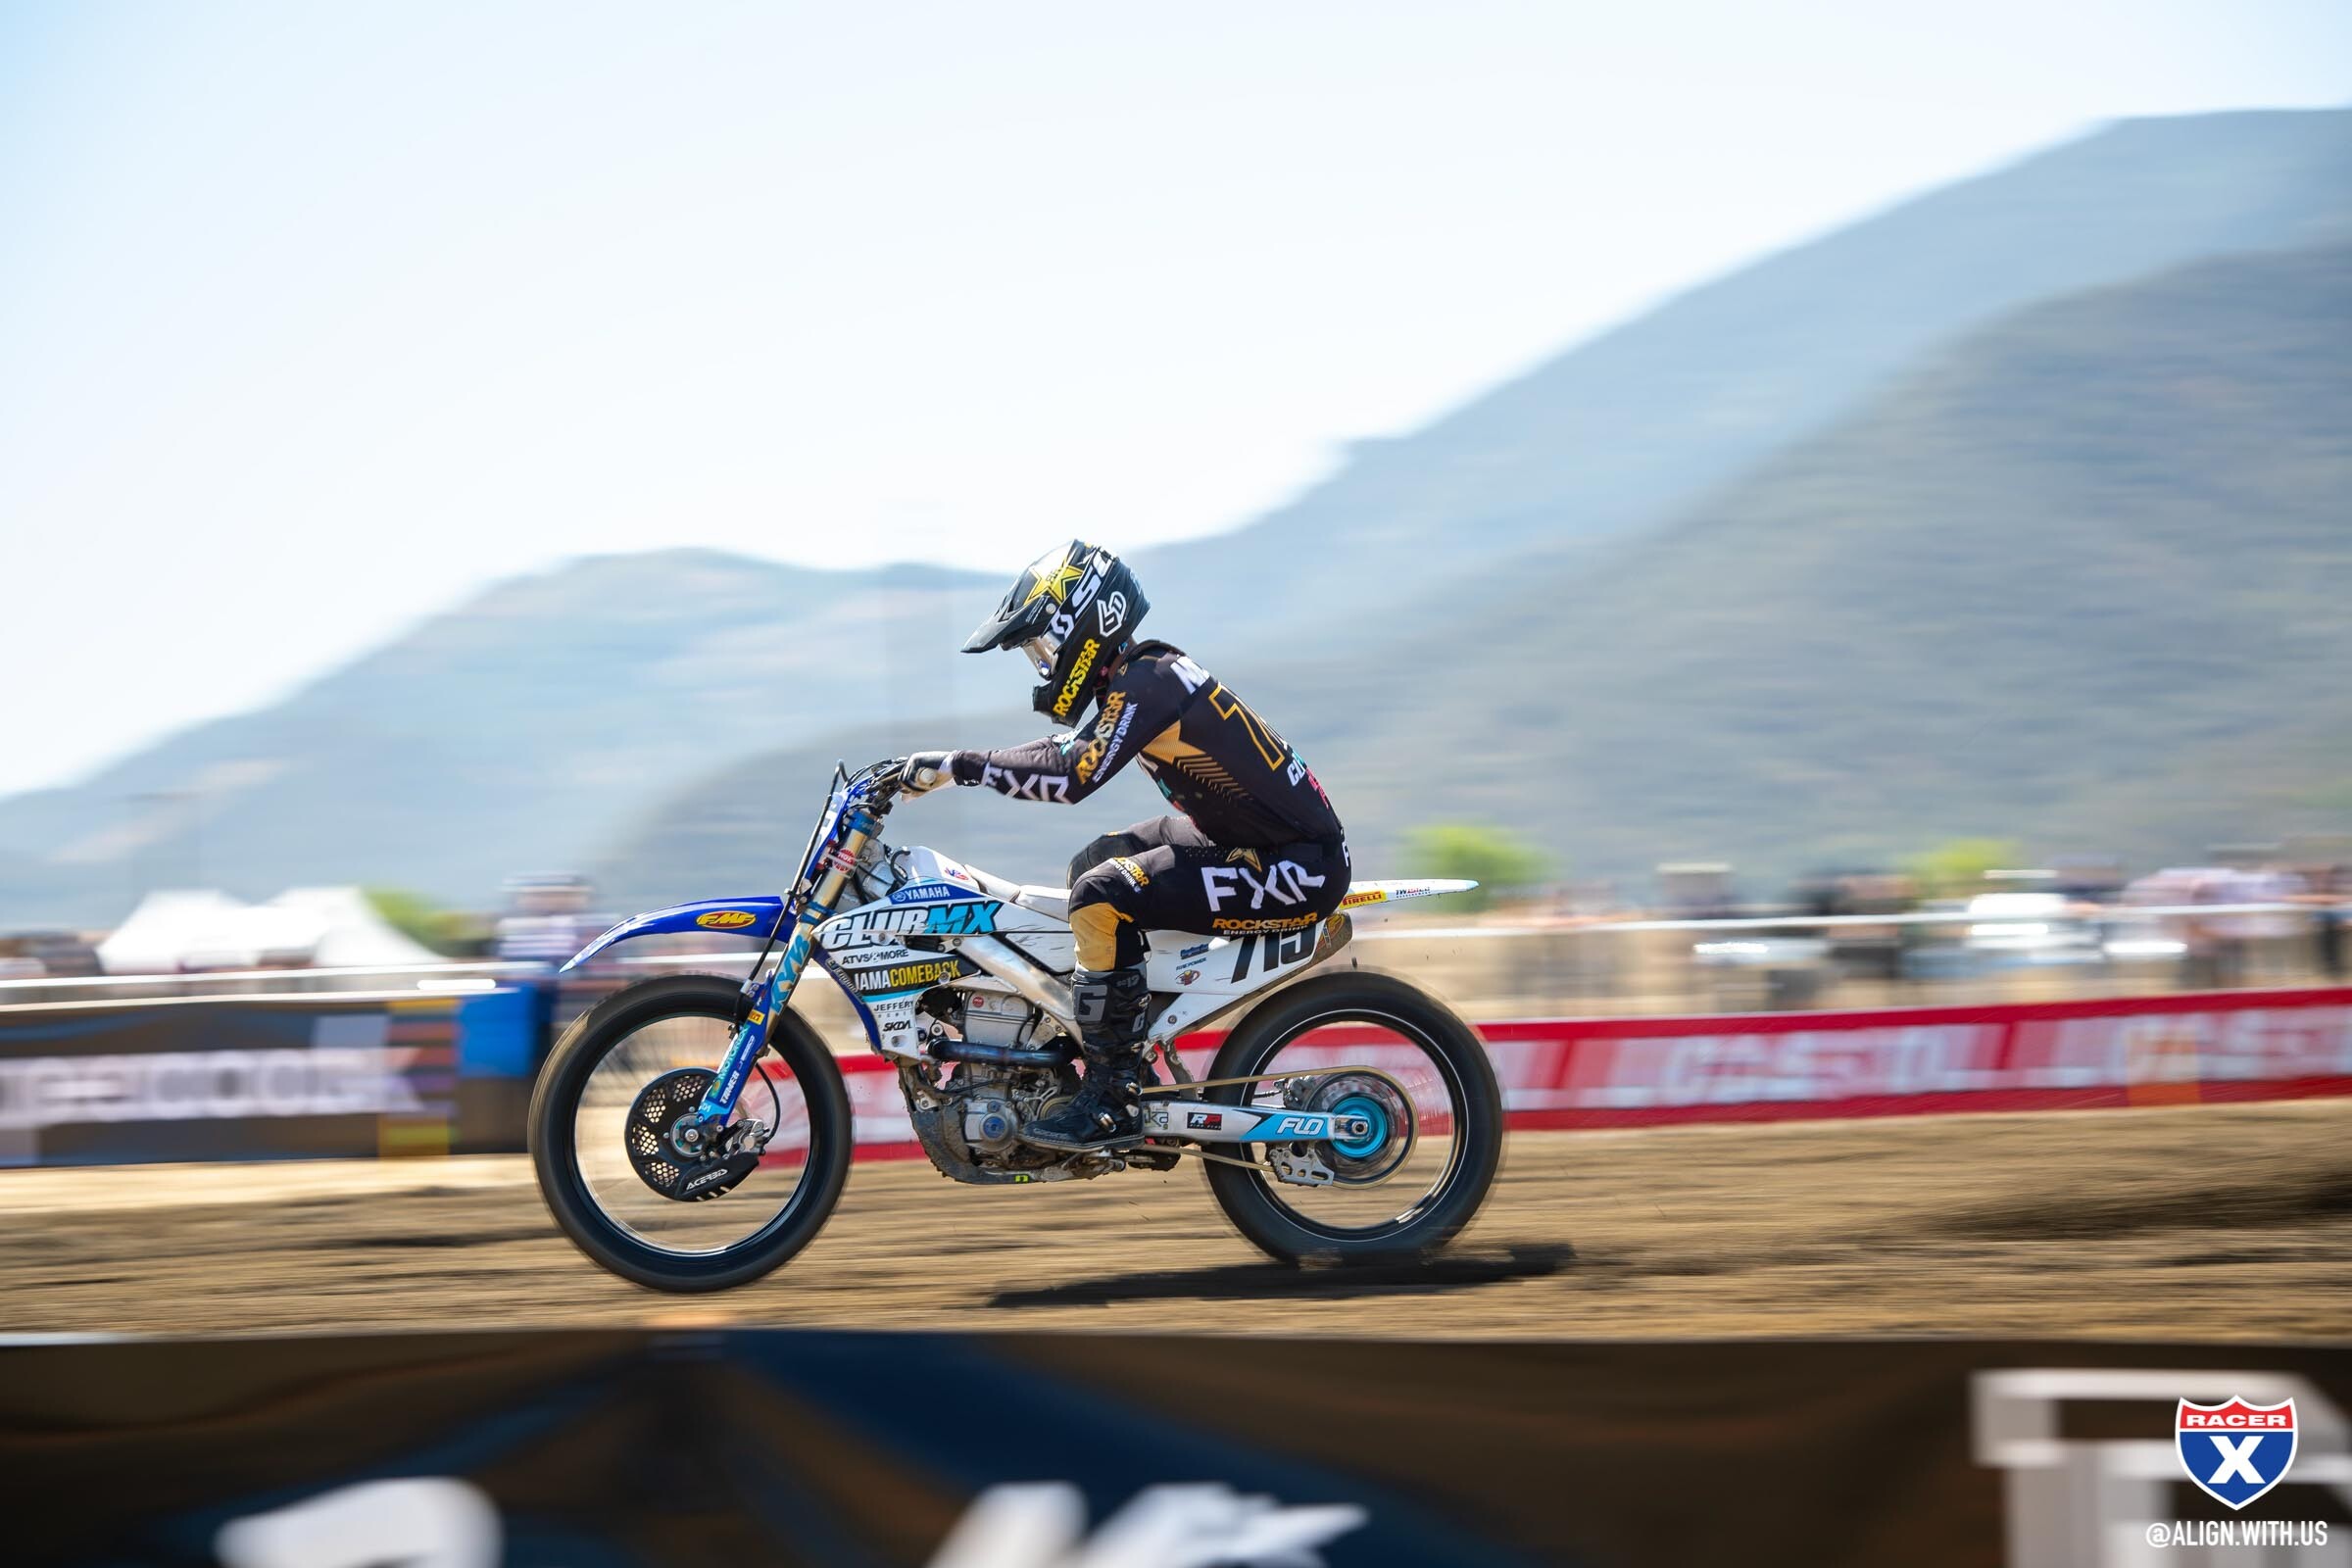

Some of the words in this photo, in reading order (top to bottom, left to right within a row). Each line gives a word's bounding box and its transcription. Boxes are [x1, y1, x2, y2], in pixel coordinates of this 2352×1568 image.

[1053, 638, 1101, 717] ROCKSTAR
[1115, 701, 1139, 738] DRINK
[1075, 691, 1127, 785] ROCKSTAR
[904, 886, 951, 901] YAMAHA
[1200, 860, 1326, 912] FXR
[1341, 891, 1383, 906] PIRELLI
[698, 911, 758, 926] FMF
[1211, 911, 1318, 930] ROCKSTAR
[1223, 927, 1271, 936] ENERGY
[1276, 1116, 1325, 1136] FLO
[686, 1168, 729, 1192] ACERBIS
